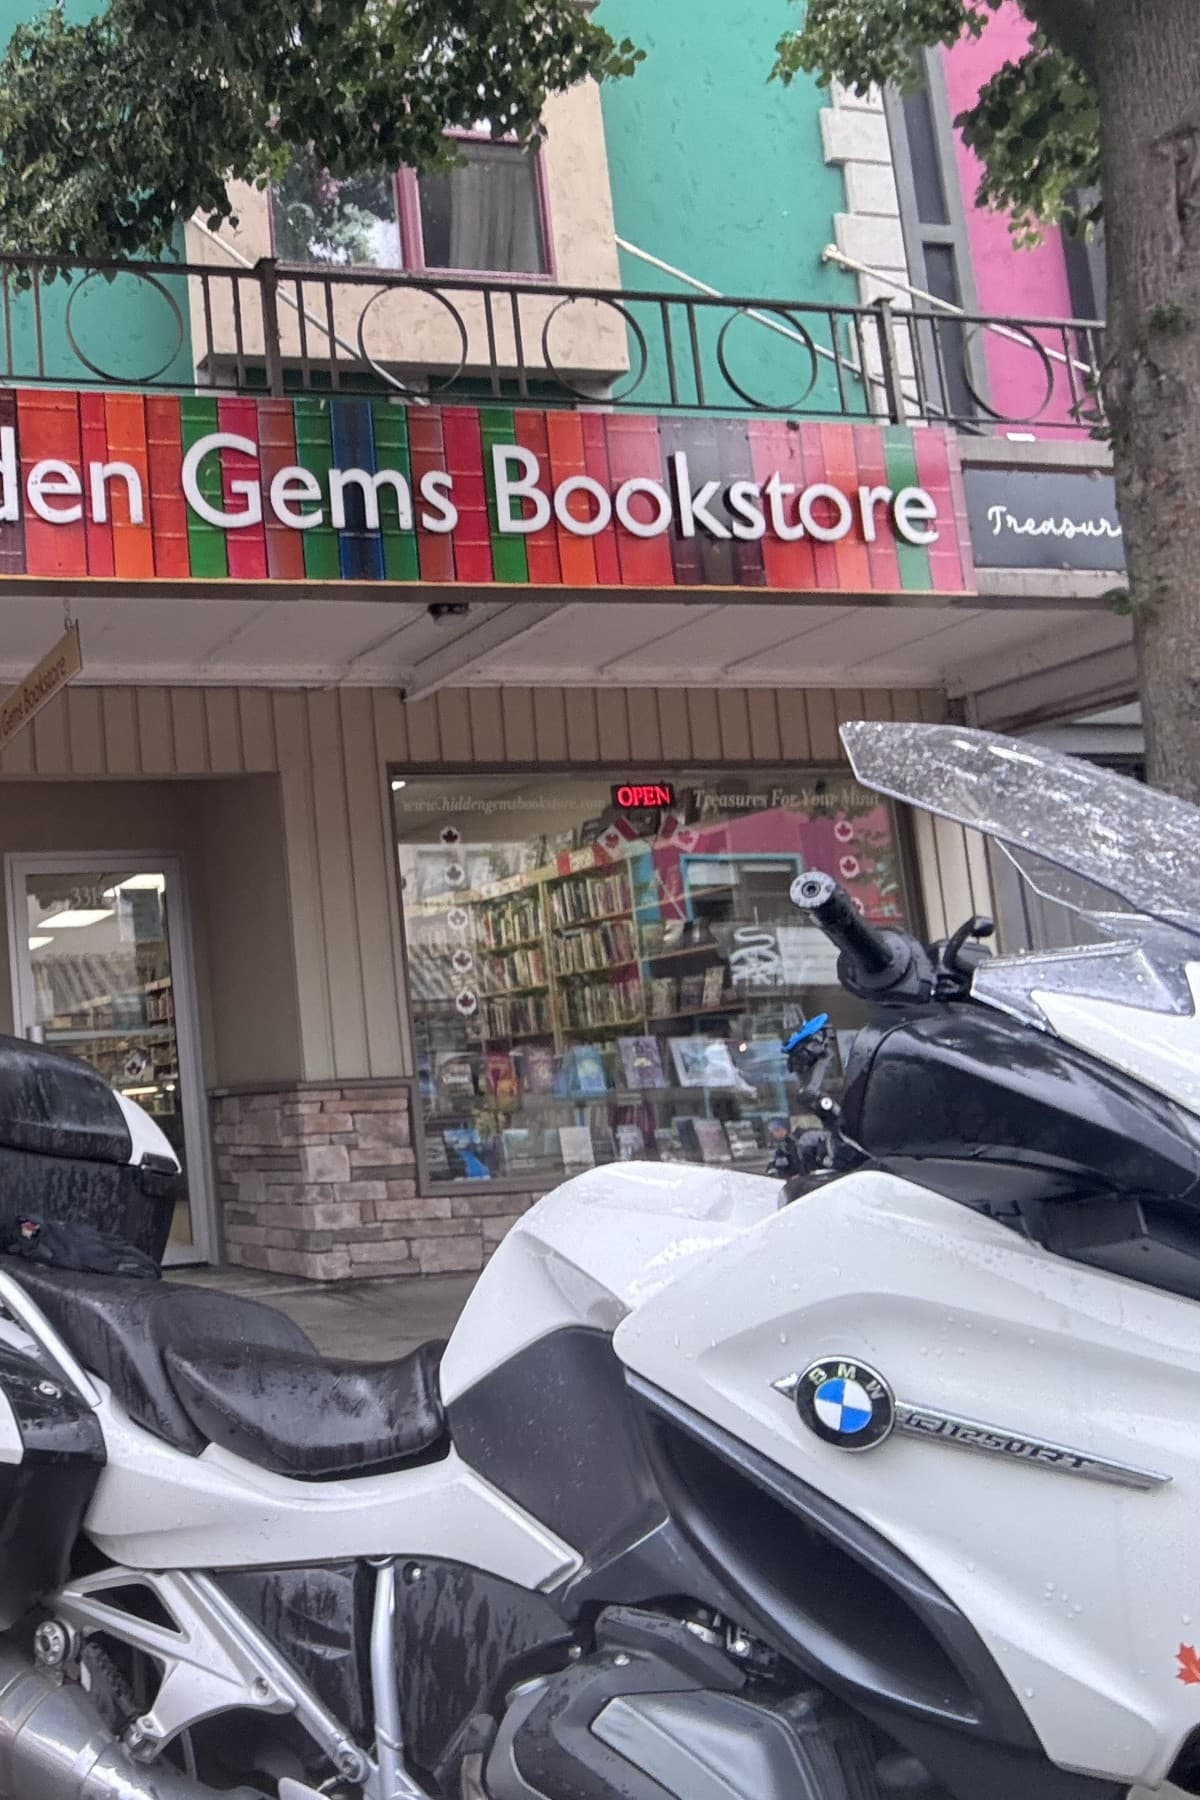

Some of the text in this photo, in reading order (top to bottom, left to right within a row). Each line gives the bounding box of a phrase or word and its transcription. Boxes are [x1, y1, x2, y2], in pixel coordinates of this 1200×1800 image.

[180, 432, 460, 534] Gems
[491, 443, 940, 546] Bookstore
[617, 786, 671, 808] OPEN
[693, 788, 768, 810] Treasures
[771, 787, 796, 807] For
[800, 788, 837, 807] Your
[808, 1362, 886, 1400] BMW
